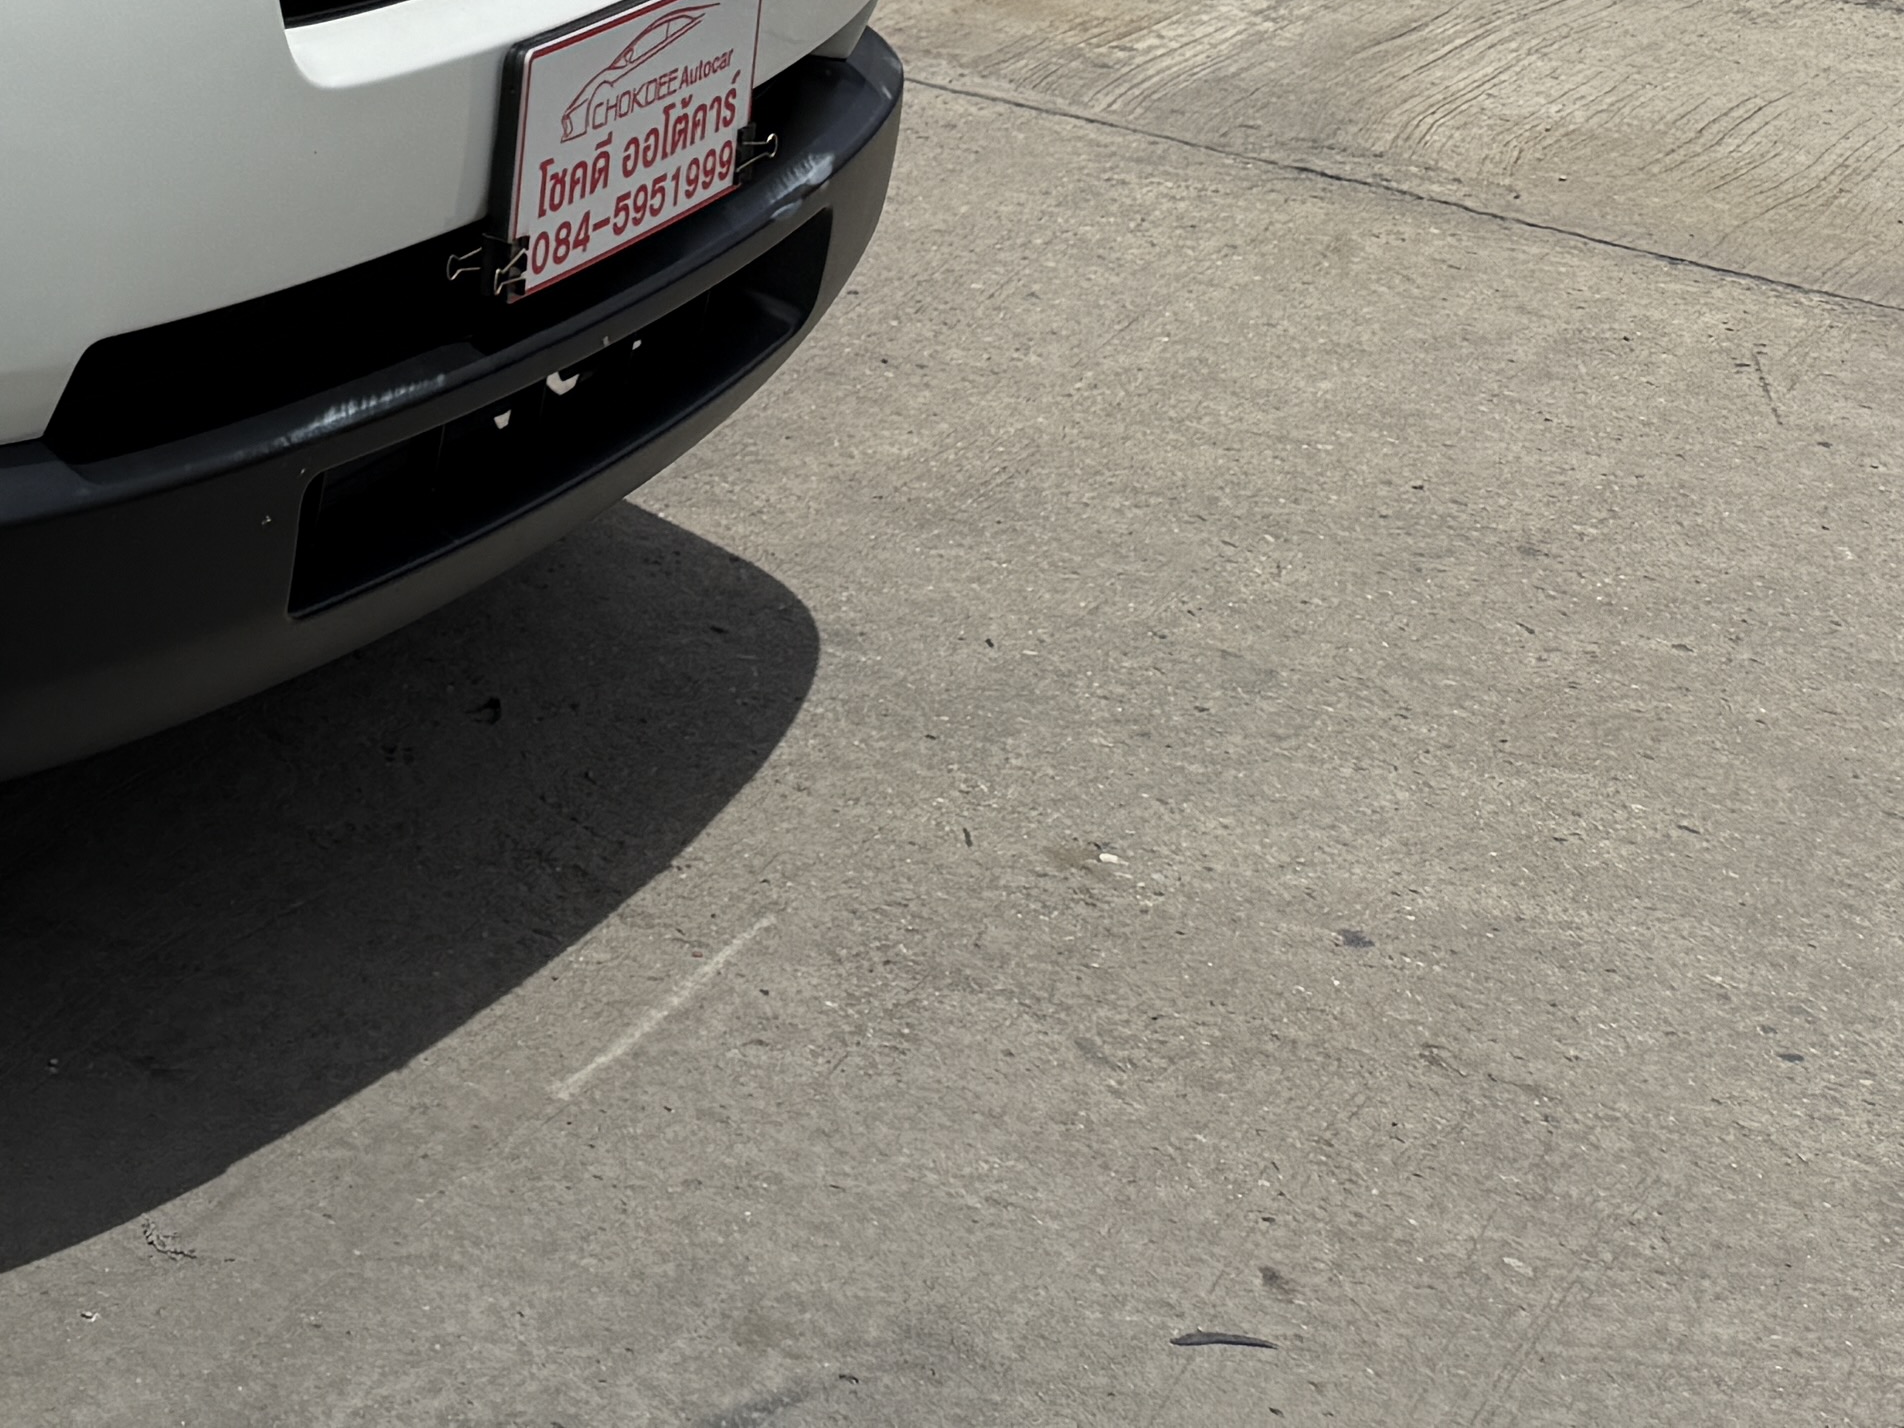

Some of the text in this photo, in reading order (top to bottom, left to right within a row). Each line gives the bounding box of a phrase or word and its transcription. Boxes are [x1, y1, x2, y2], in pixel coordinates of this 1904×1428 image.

[538, 69, 741, 219] โชคดี ออโต้คาร์
[592, 48, 734, 130] CHOKDEE Autocar
[531, 140, 734, 275] 084-5951999
